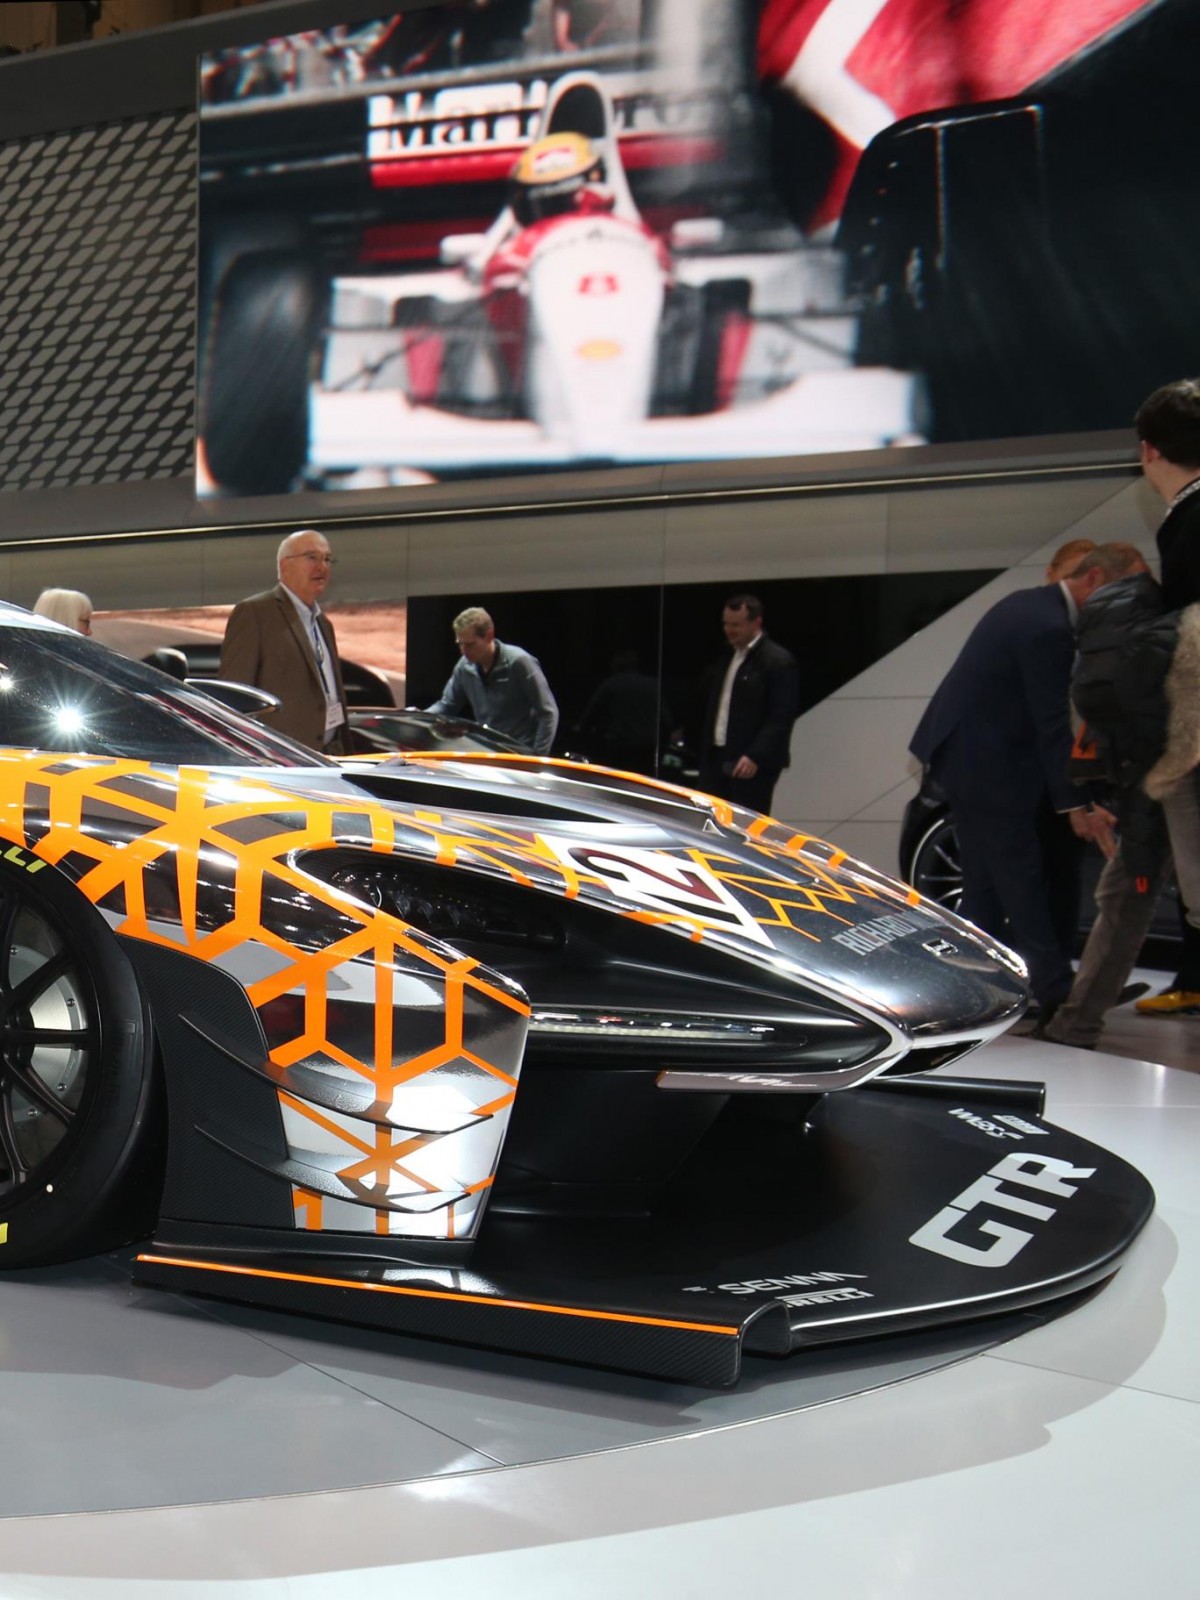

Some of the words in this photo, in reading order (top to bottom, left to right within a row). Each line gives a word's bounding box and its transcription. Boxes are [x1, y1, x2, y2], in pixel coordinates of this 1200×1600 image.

[831, 914, 918, 957] RICHARD
[908, 1152, 1098, 1268] GTR
[717, 1271, 869, 1296] SENNA
